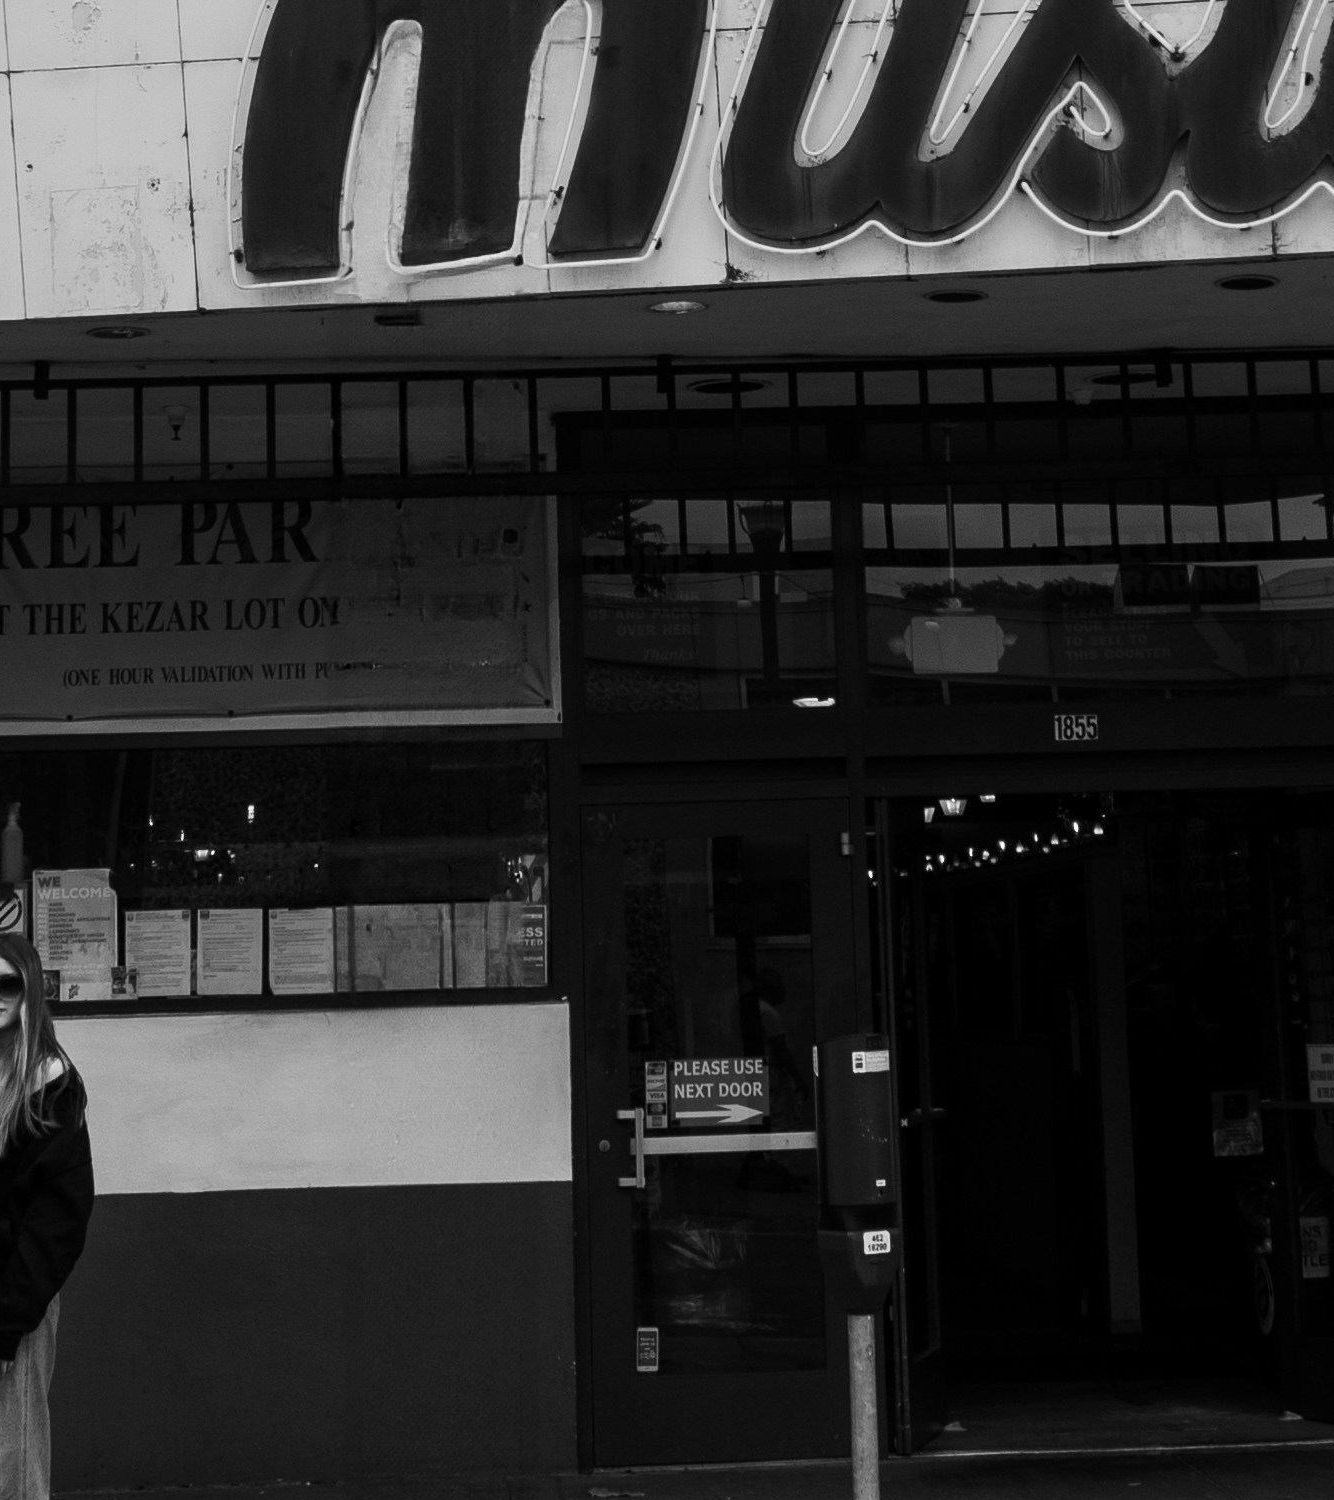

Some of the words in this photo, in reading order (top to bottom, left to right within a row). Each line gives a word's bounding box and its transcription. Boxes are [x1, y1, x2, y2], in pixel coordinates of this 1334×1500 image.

[1108, 570, 1252, 595] RADING
[23, 603, 87, 635] THE
[100, 600, 210, 634] KEZAR
[224, 598, 285, 630] LOT
[615, 608, 645, 620] AND
[617, 624, 656, 637] OVER
[662, 623, 701, 635] HERE
[1063, 636, 1083, 647] TO
[1090, 634, 1123, 646] SELL
[1066, 649, 1099, 661] THIS
[1104, 647, 1172, 660] COUNTER
[63, 667, 101, 688] (ONE
[109, 666, 154, 685] HOUR
[161, 664, 254, 684] VALIDATION
[261, 662, 307, 681] WITH
[1055, 715, 1097, 740] 1855
[37, 876, 61, 888] WE
[37, 887, 112, 900] WELCOME
[674, 1060, 729, 1077] PLEASE
[734, 1059, 763, 1075] USE
[674, 1083, 714, 1099] NEXT
[718, 1081, 764, 1097] DOOR
